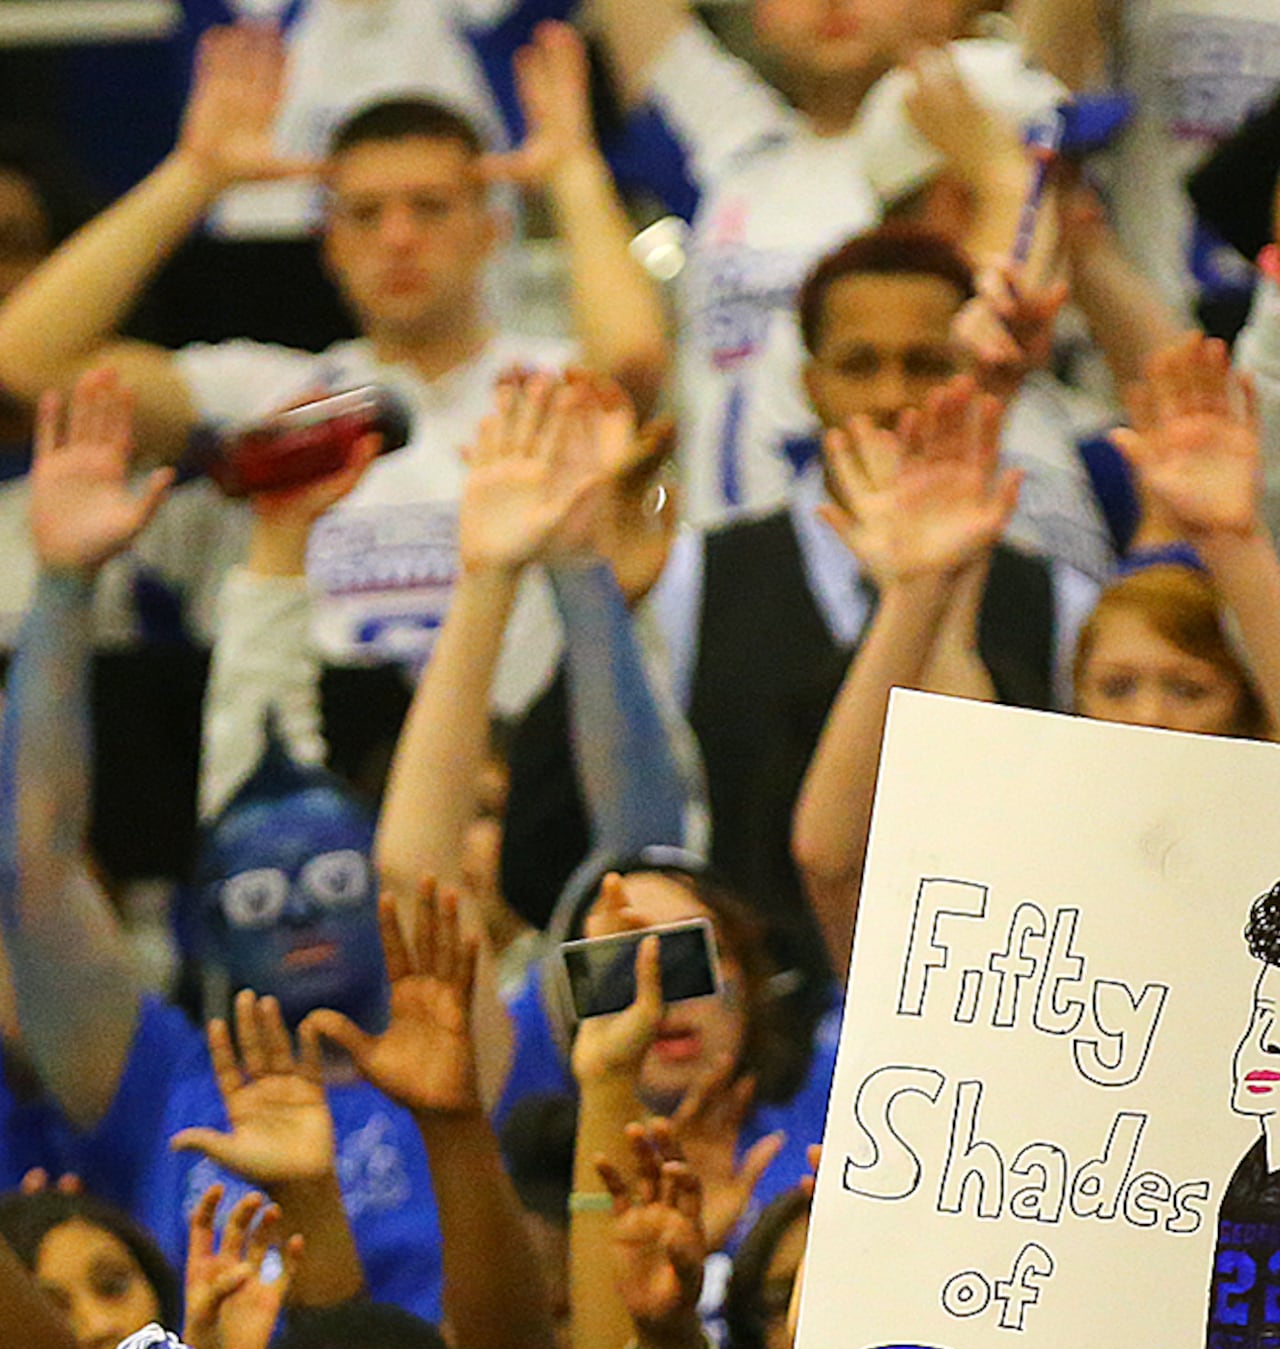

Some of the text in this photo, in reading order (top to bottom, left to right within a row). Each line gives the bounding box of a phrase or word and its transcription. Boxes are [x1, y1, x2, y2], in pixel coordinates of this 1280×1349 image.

[897, 877, 1169, 1086] Fifty
[843, 1065, 1209, 1233] Shades
[942, 1242, 1054, 1330] of
